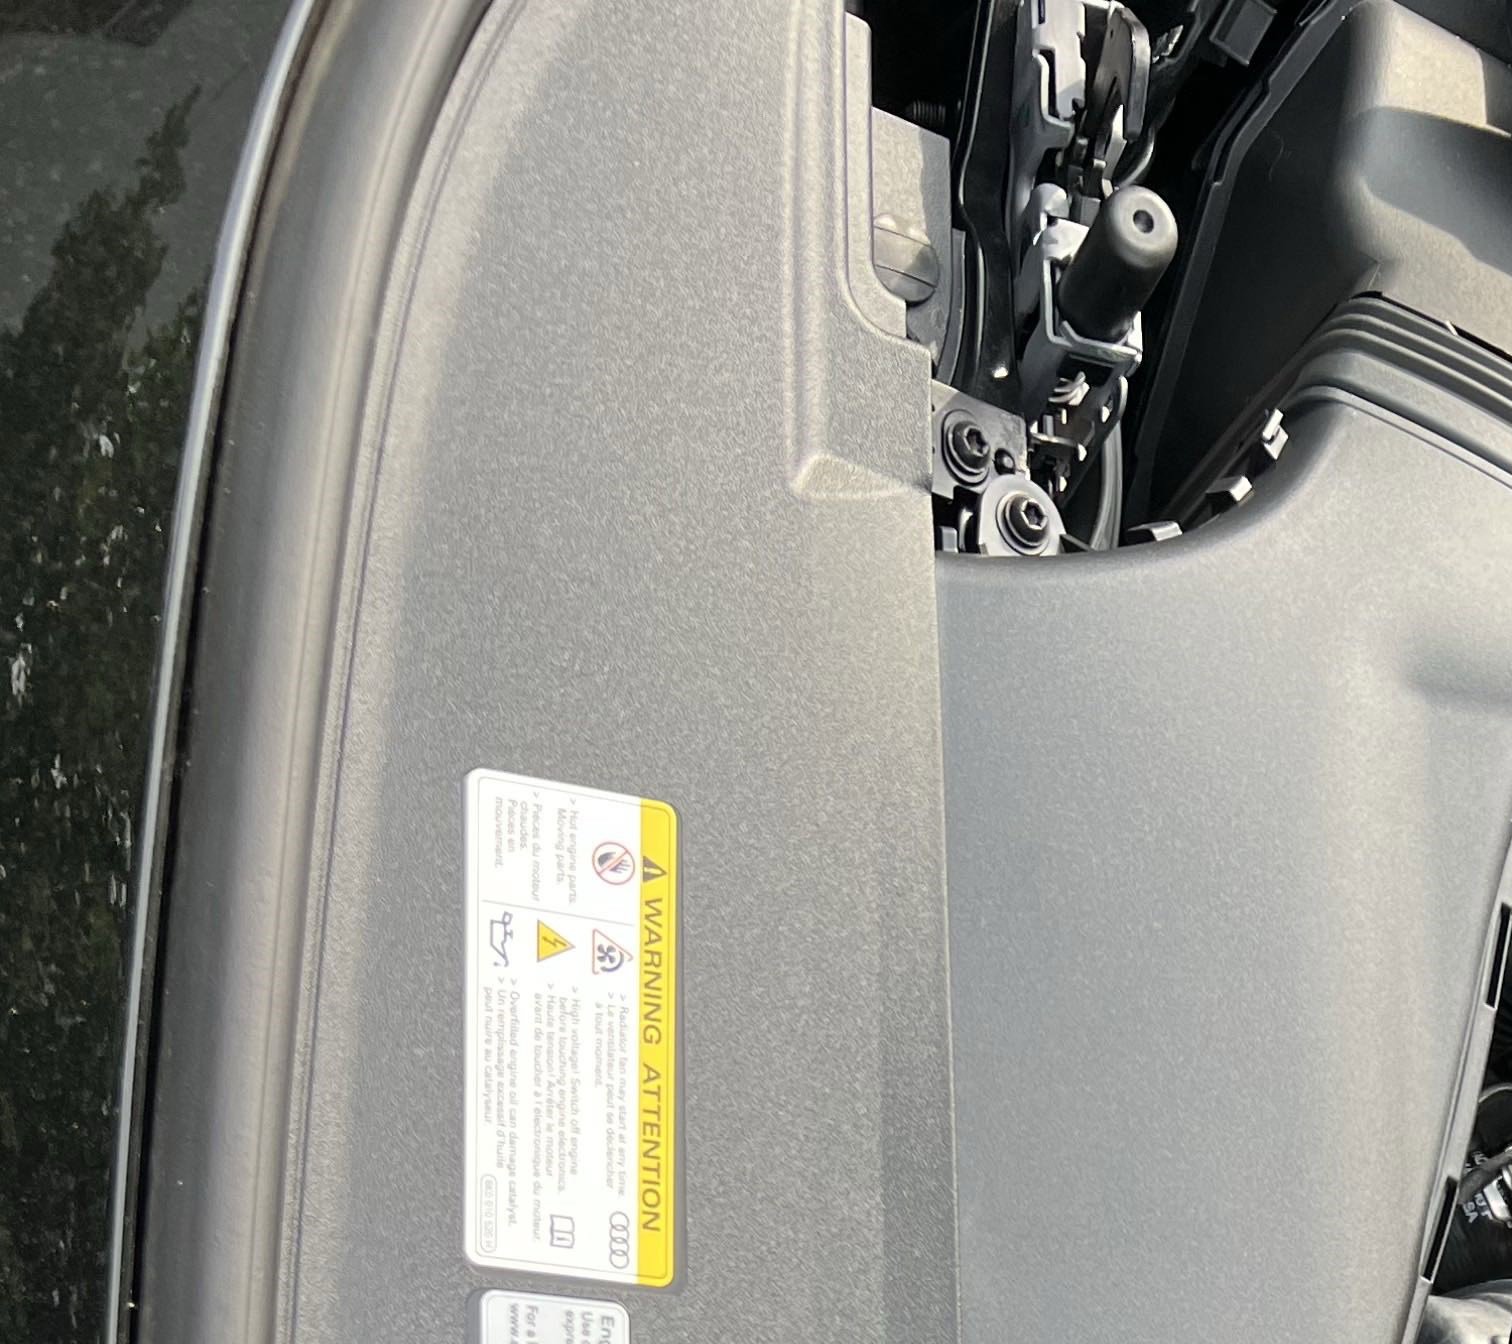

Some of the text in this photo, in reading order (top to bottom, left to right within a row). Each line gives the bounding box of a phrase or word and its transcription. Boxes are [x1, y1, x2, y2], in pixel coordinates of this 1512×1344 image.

[520, 801, 530, 850] chaudes.
[569, 810, 578, 830] Hot
[508, 838, 516, 852] en
[533, 843, 542, 857] du
[555, 808, 566, 884] Moving parts.
[567, 833, 577, 871] engine
[532, 860, 540, 902] moteur
[482, 986, 494, 1012] peut
[496, 989, 506, 1006] Un
[534, 993, 543, 1024] avant
[509, 990, 519, 1046] Overfilled
[546, 995, 556, 1027] Haute
[558, 997, 568, 1033] before
[594, 1012, 604, 1034] tout
[606, 1004, 616, 1018] Le
[484, 1016, 494, 1046] nuire
[534, 1028, 544, 1041] de
[618, 1007, 629, 1053] Radiator
[484, 1049, 492, 1062] au
[494, 1009, 506, 1078] remplissage
[606, 1022, 616, 1080] ventilateur
[507, 1050, 518, 1088] engine
[534, 1046, 544, 1087] toucher
[556, 1036, 568, 1086] touching
[618, 1057, 628, 1074] fan
[641, 898, 665, 1232] WARNING ATTENTION
[510, 1092, 519, 1105] oil
[567, 999, 580, 1175] High voltage! Switch off engine
[604, 1084, 615, 1108] peut
[616, 1079, 627, 1101] may
[496, 1082, 506, 1126] excessif
[556, 1089, 566, 1127] engine
[508, 1108, 517, 1128] can
[546, 1123, 555, 1132] le
[606, 1112, 614, 1124] se
[618, 1106, 628, 1130] start
[618, 1134, 628, 1144] at
[506, 1132, 518, 1177] damage
[546, 1136, 554, 1177] moteur
[616, 1148, 626, 1168] any
[533, 1182, 542, 1196] du
[526, 1305, 538, 1327] For
[581, 1311, 593, 1336] Use
[526, 1330, 536, 1338] a
